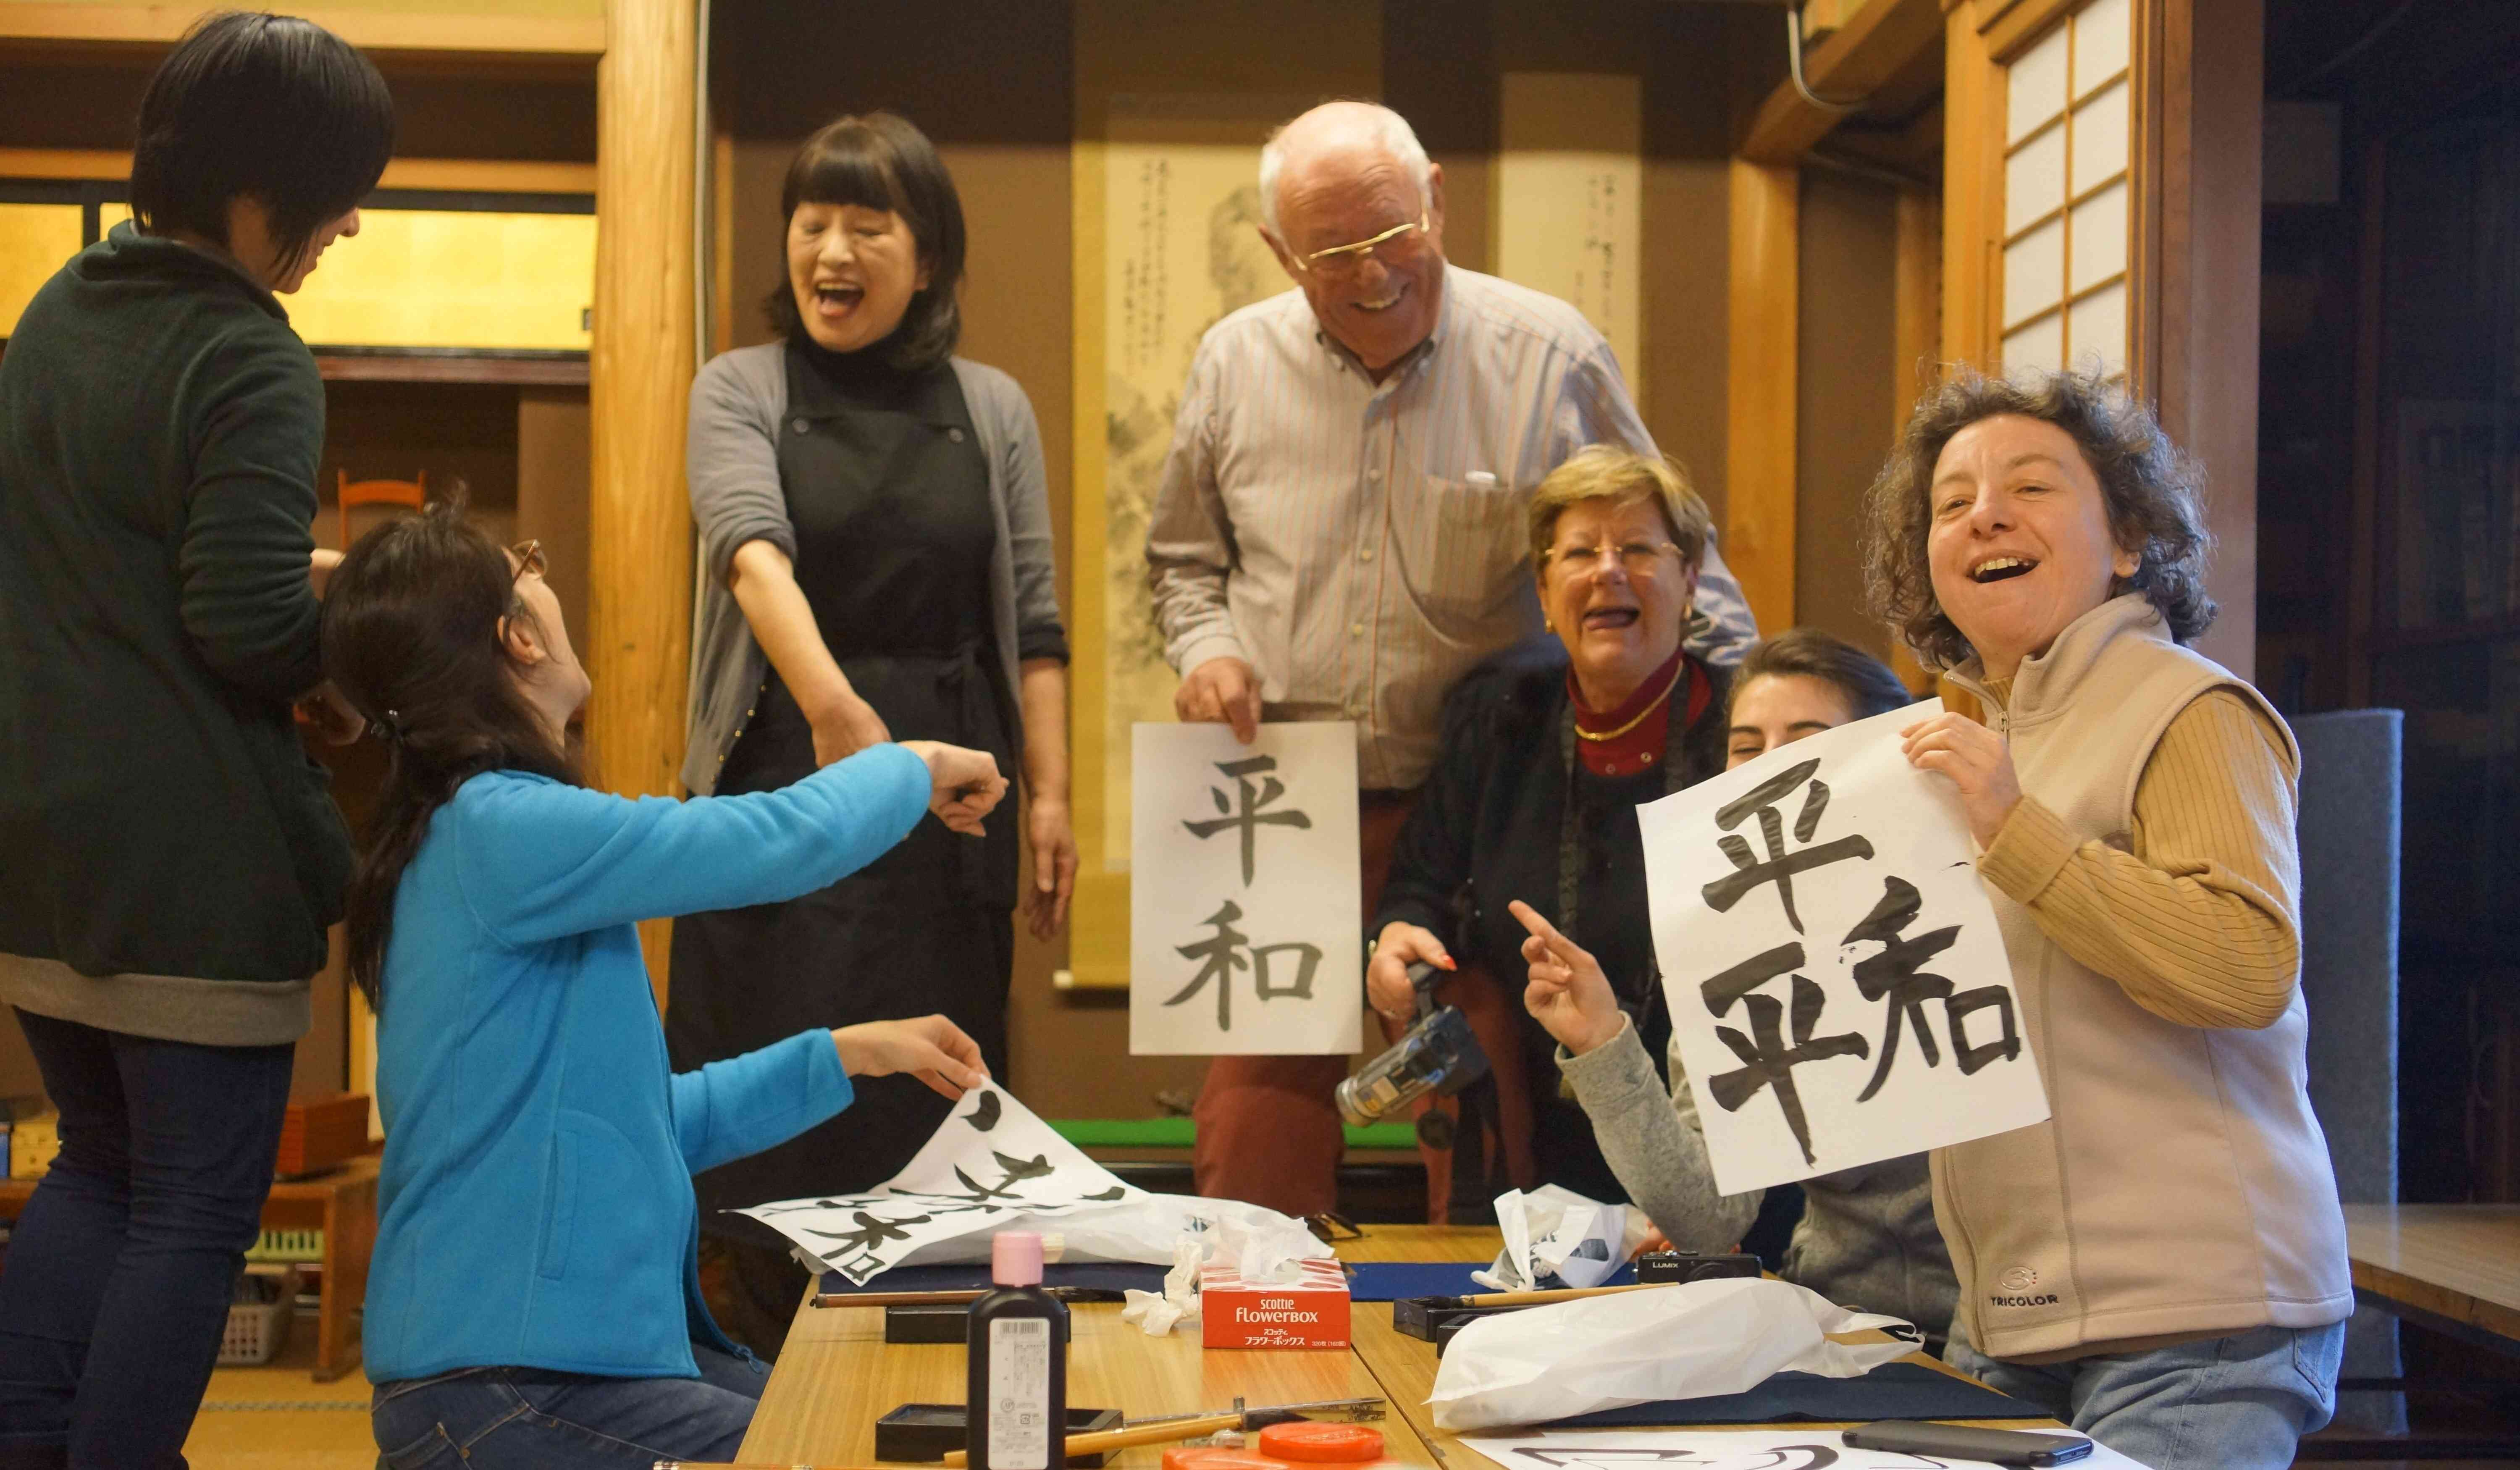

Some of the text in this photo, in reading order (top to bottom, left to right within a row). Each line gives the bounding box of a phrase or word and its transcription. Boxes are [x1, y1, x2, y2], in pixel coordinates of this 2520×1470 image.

[1162, 755, 1323, 1032] 平和
[1260, 1298, 1295, 1310] scottie
[1990, 1294, 2059, 1307] TRICOLOR
[1244, 1336, 1305, 1346] フラワーボックス
